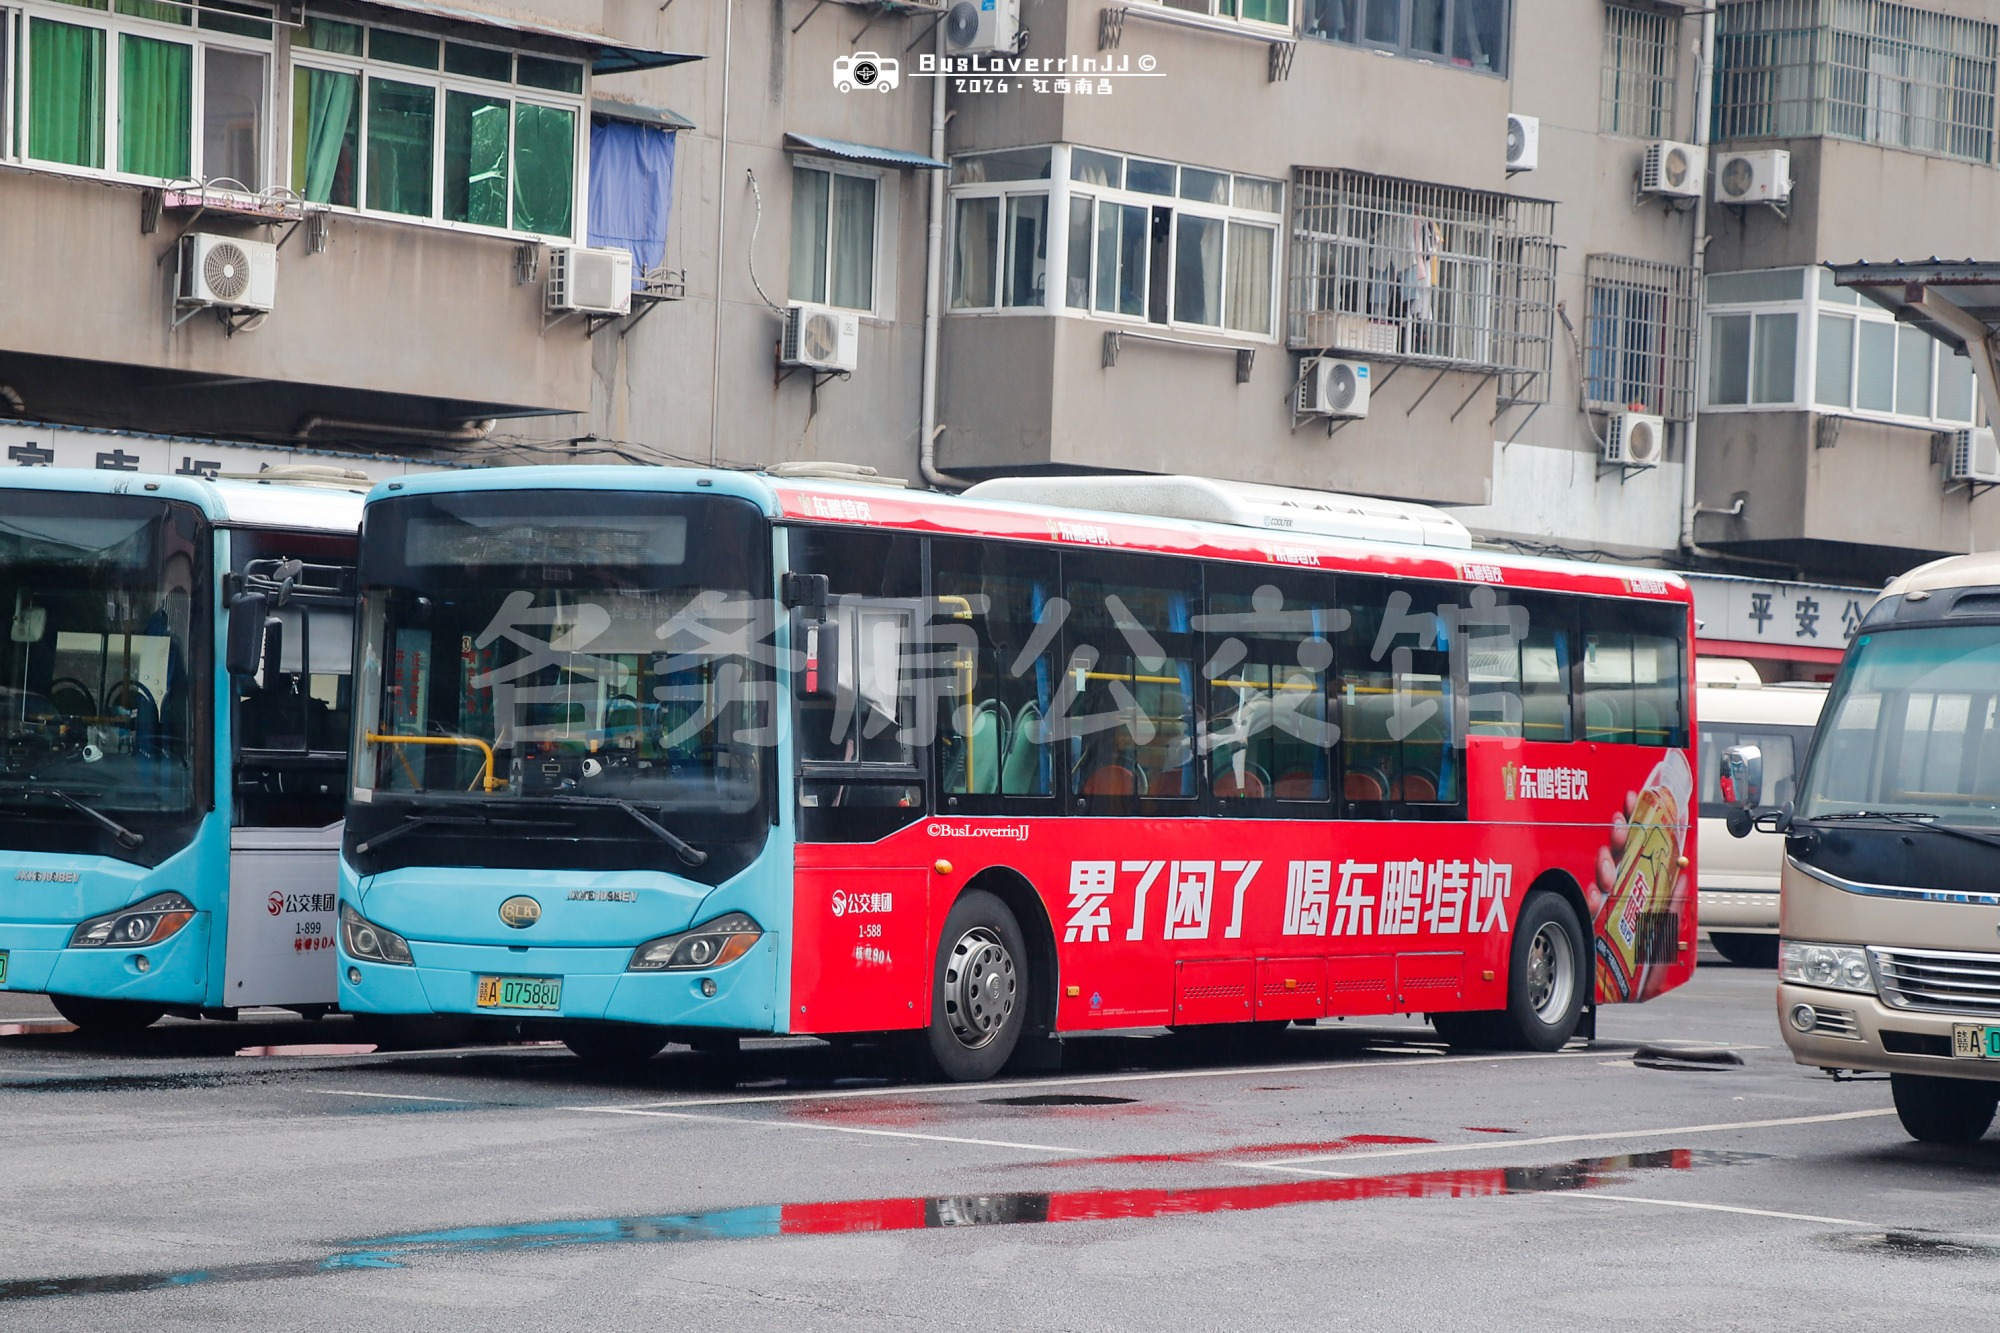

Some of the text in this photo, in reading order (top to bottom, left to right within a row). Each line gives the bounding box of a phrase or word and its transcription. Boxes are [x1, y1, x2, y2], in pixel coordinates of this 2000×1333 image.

[1519, 765, 1589, 800] 东鹏特饮
[285, 893, 335, 913] 公交集团
[847, 892, 892, 914] 公交集团
[1063, 857, 1513, 943] 累了困了 喝东鹏特饮
[295, 922, 322, 934] 1-899
[858, 924, 882, 938] 1-588
[504, 982, 560, 1005] 07588D
